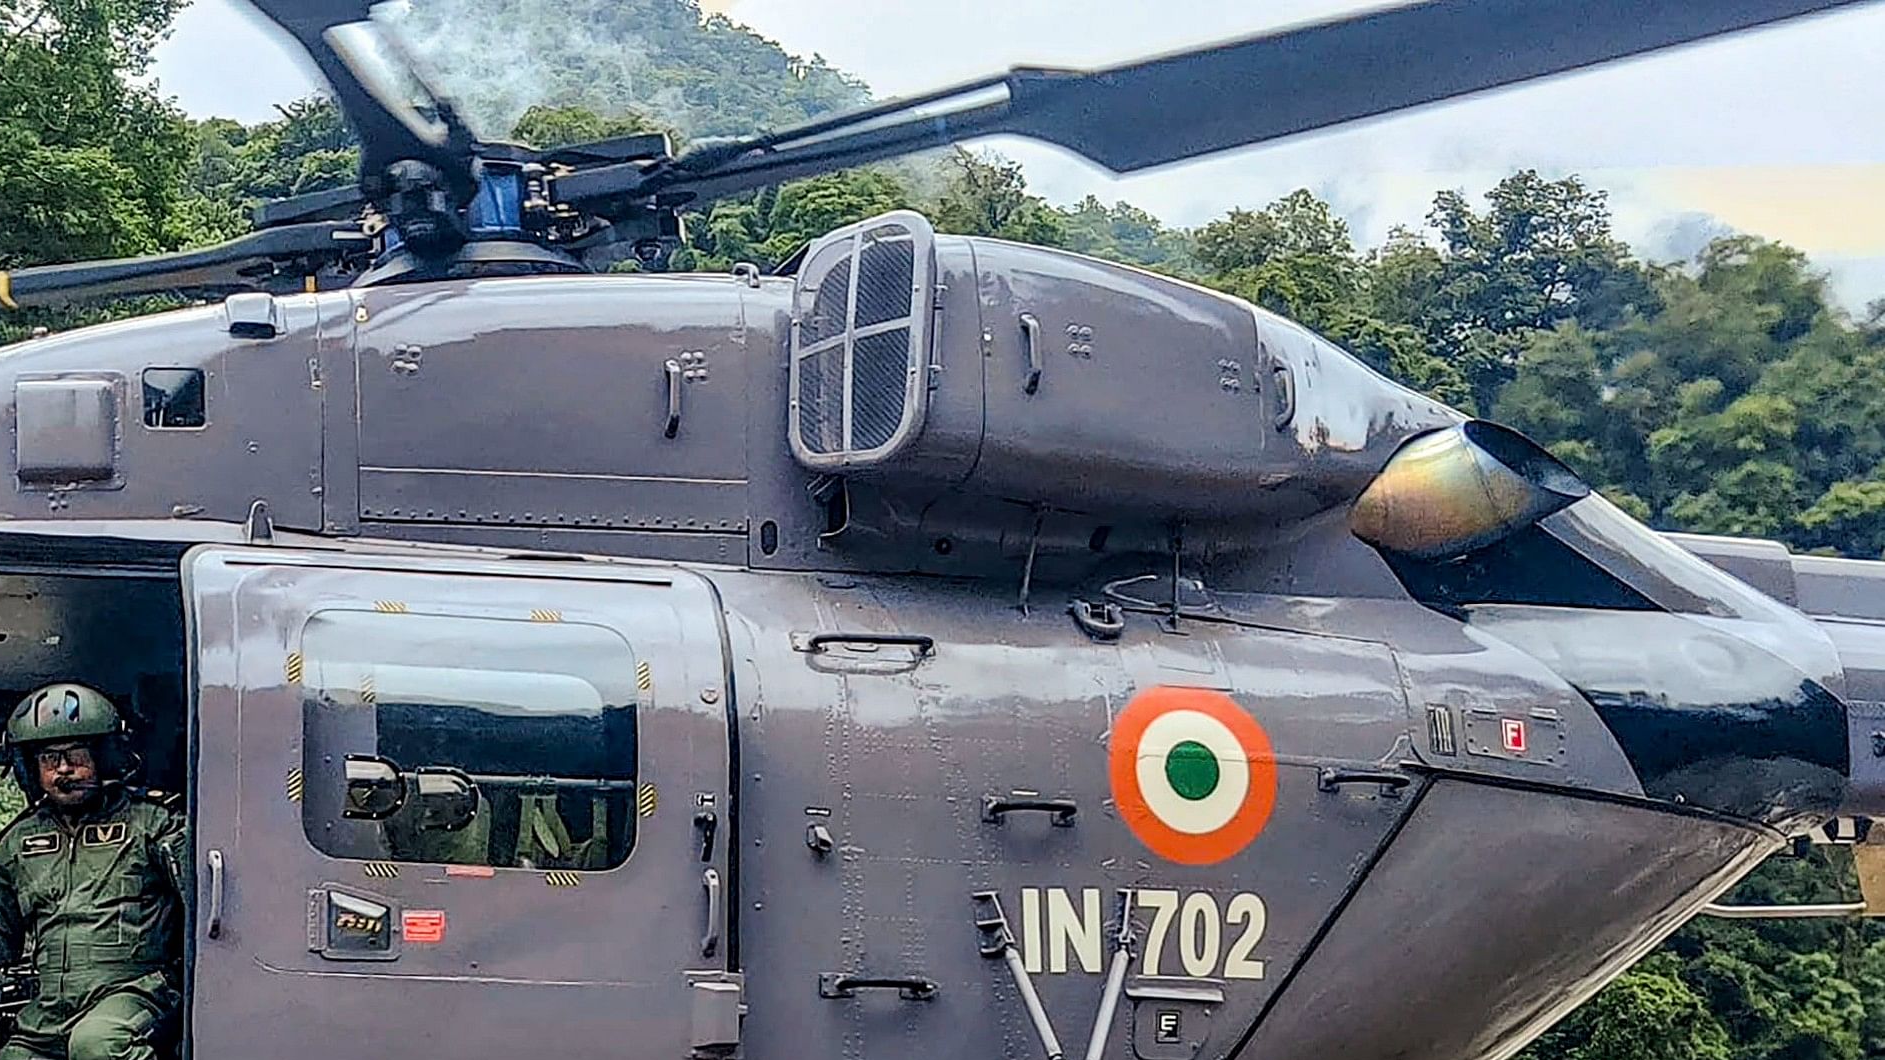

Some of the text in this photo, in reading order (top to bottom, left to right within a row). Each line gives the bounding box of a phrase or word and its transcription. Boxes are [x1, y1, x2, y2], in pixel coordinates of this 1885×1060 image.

[1506, 723, 1519, 746] F
[1021, 888, 1266, 979] IN 702
